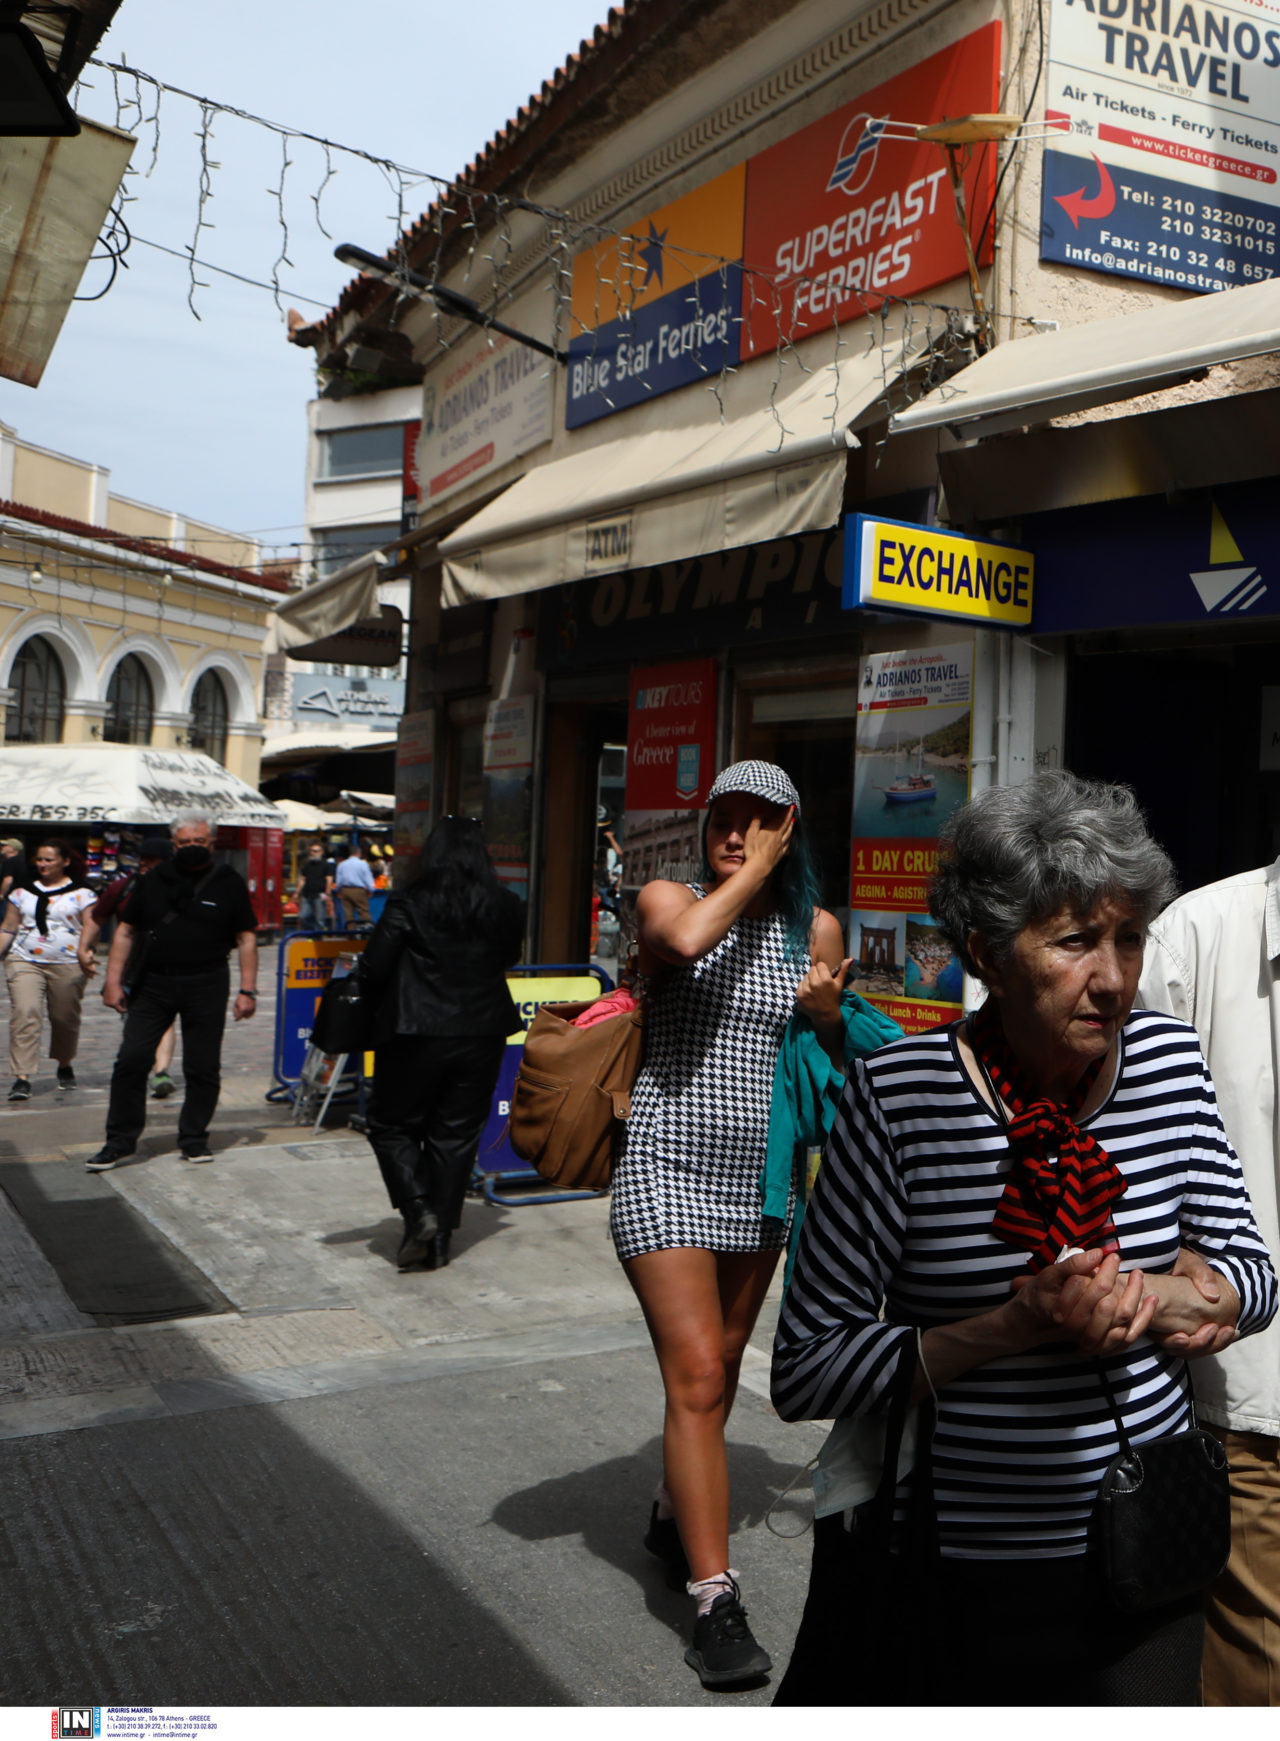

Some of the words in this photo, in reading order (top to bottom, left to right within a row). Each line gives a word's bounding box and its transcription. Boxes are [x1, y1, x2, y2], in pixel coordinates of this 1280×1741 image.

[1098, 22, 1250, 104] TRAVEL
[1158, 82, 1175, 94] since
[1062, 85, 1088, 103] Air
[1093, 92, 1157, 121] Tickets
[1172, 114, 1215, 140] Ferry
[1220, 127, 1279, 154] Tickets
[1131, 135, 1270, 182] www.ticketgreece.gr
[774, 167, 948, 283] SUPERFAST
[1120, 185, 1155, 206] Tel:
[1162, 196, 1195, 216] 210
[1201, 206, 1276, 236] 3220702
[1161, 216, 1194, 236] 210
[1200, 226, 1275, 255] 3231015
[1065, 244, 1248, 291] info@adrianostrav
[1100, 230, 1139, 252] Fax:
[1147, 241, 1180, 261] 210
[1187, 250, 1209, 267] 32
[1215, 257, 1236, 274] 48
[1243, 263, 1275, 281] 657
[794, 235, 913, 319] FERRIES
[572, 356, 611, 399] Blue
[616, 338, 653, 381] Star
[658, 308, 728, 364] Ferries
[437, 368, 491, 433] ADRIANOS
[494, 345, 536, 397] TRAVEL
[591, 523, 628, 561] ATM
[878, 539, 1030, 608] EXCHANGE
[340, 625, 398, 640] EGEAN
[644, 681, 703, 709] KEYTOURS
[876, 668, 922, 688] ADRIANOS
[925, 664, 959, 683] TRAVEL
[879, 689, 887, 698] Air
[888, 688, 905, 697] Tickets
[909, 687, 922, 697] Ferry
[924, 685, 942, 694] Tickets
[633, 737, 675, 766] Greece
[857, 850, 865, 871] 1
[872, 850, 901, 872] DAY
[903, 850, 948, 873] CRU
[856, 884, 886, 898] AEGINA
[303, 957, 334, 968] TICK
[890, 1006, 911, 1018] Lunch
[917, 1008, 941, 1022] Drinks
